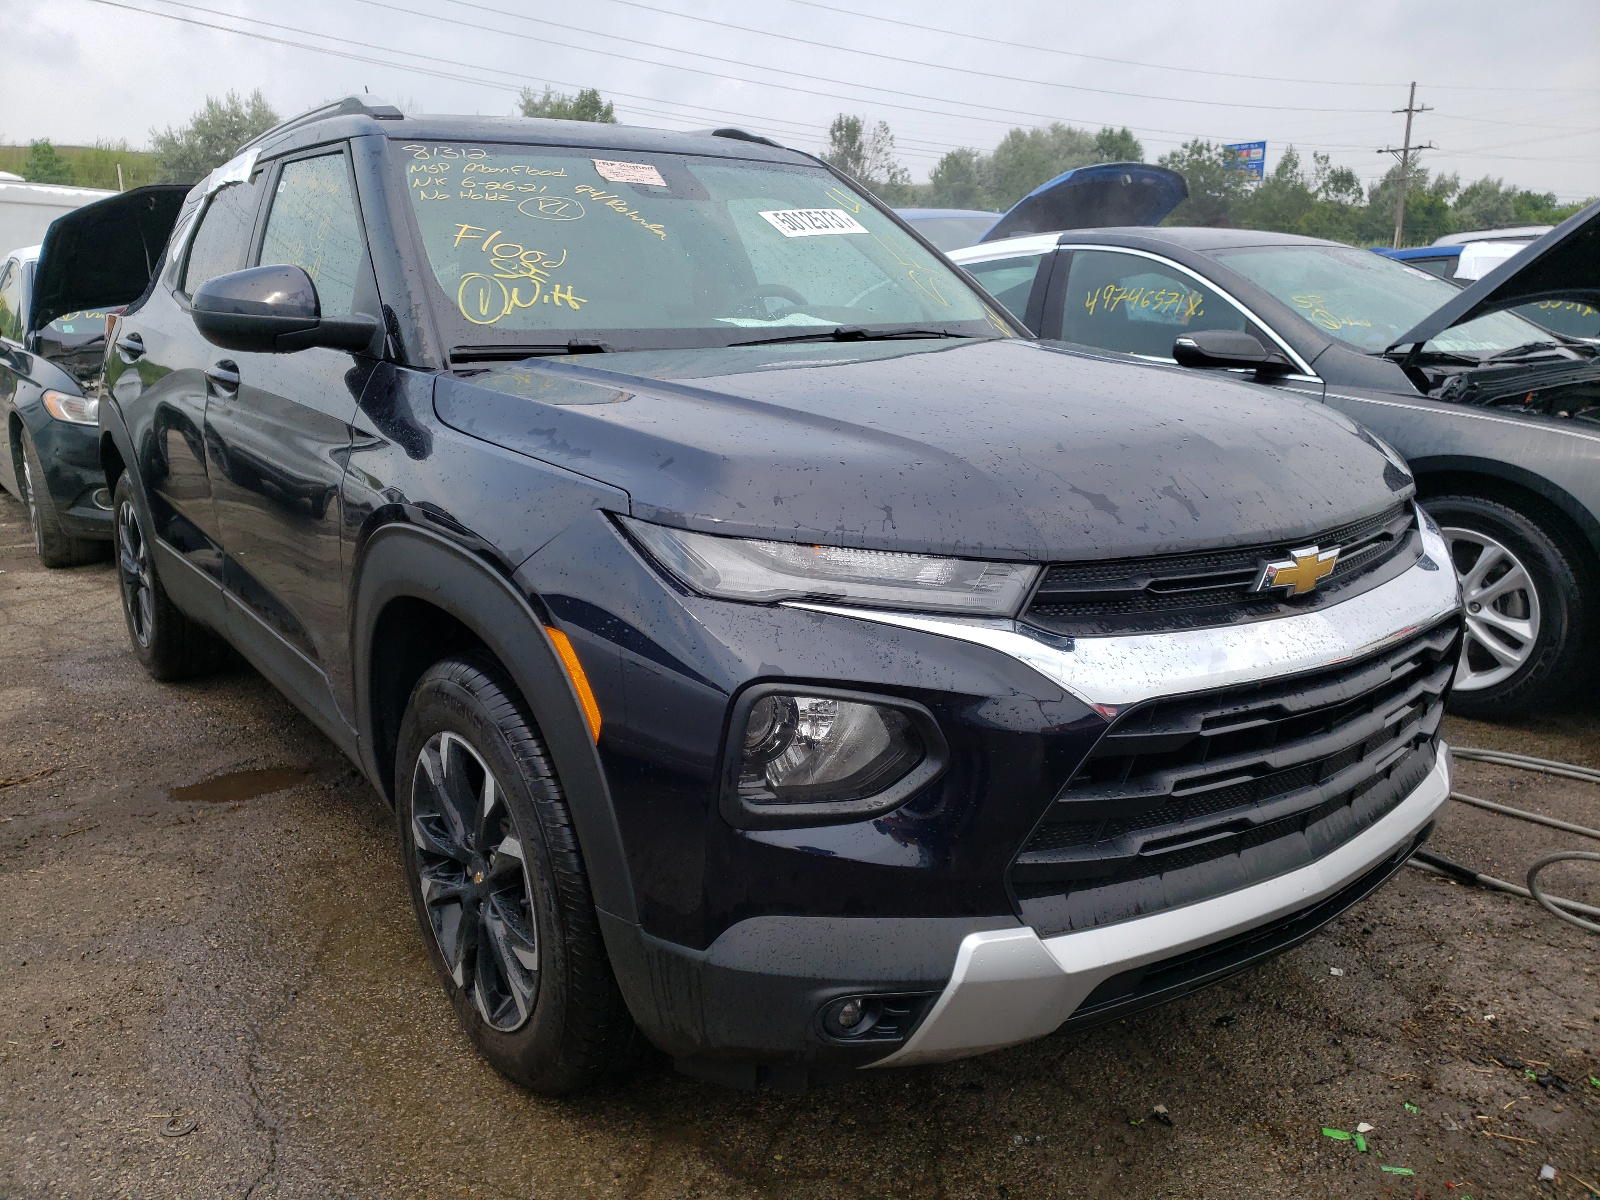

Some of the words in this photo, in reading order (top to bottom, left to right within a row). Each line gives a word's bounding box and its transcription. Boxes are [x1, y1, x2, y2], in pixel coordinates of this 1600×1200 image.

[402, 144, 488, 159] 81312
[410, 162, 450, 174] MSP
[511, 165, 567, 177] Flood
[420, 190, 450, 202] No
[772, 210, 852, 231] 50125731
[453, 223, 567, 268] Flood
